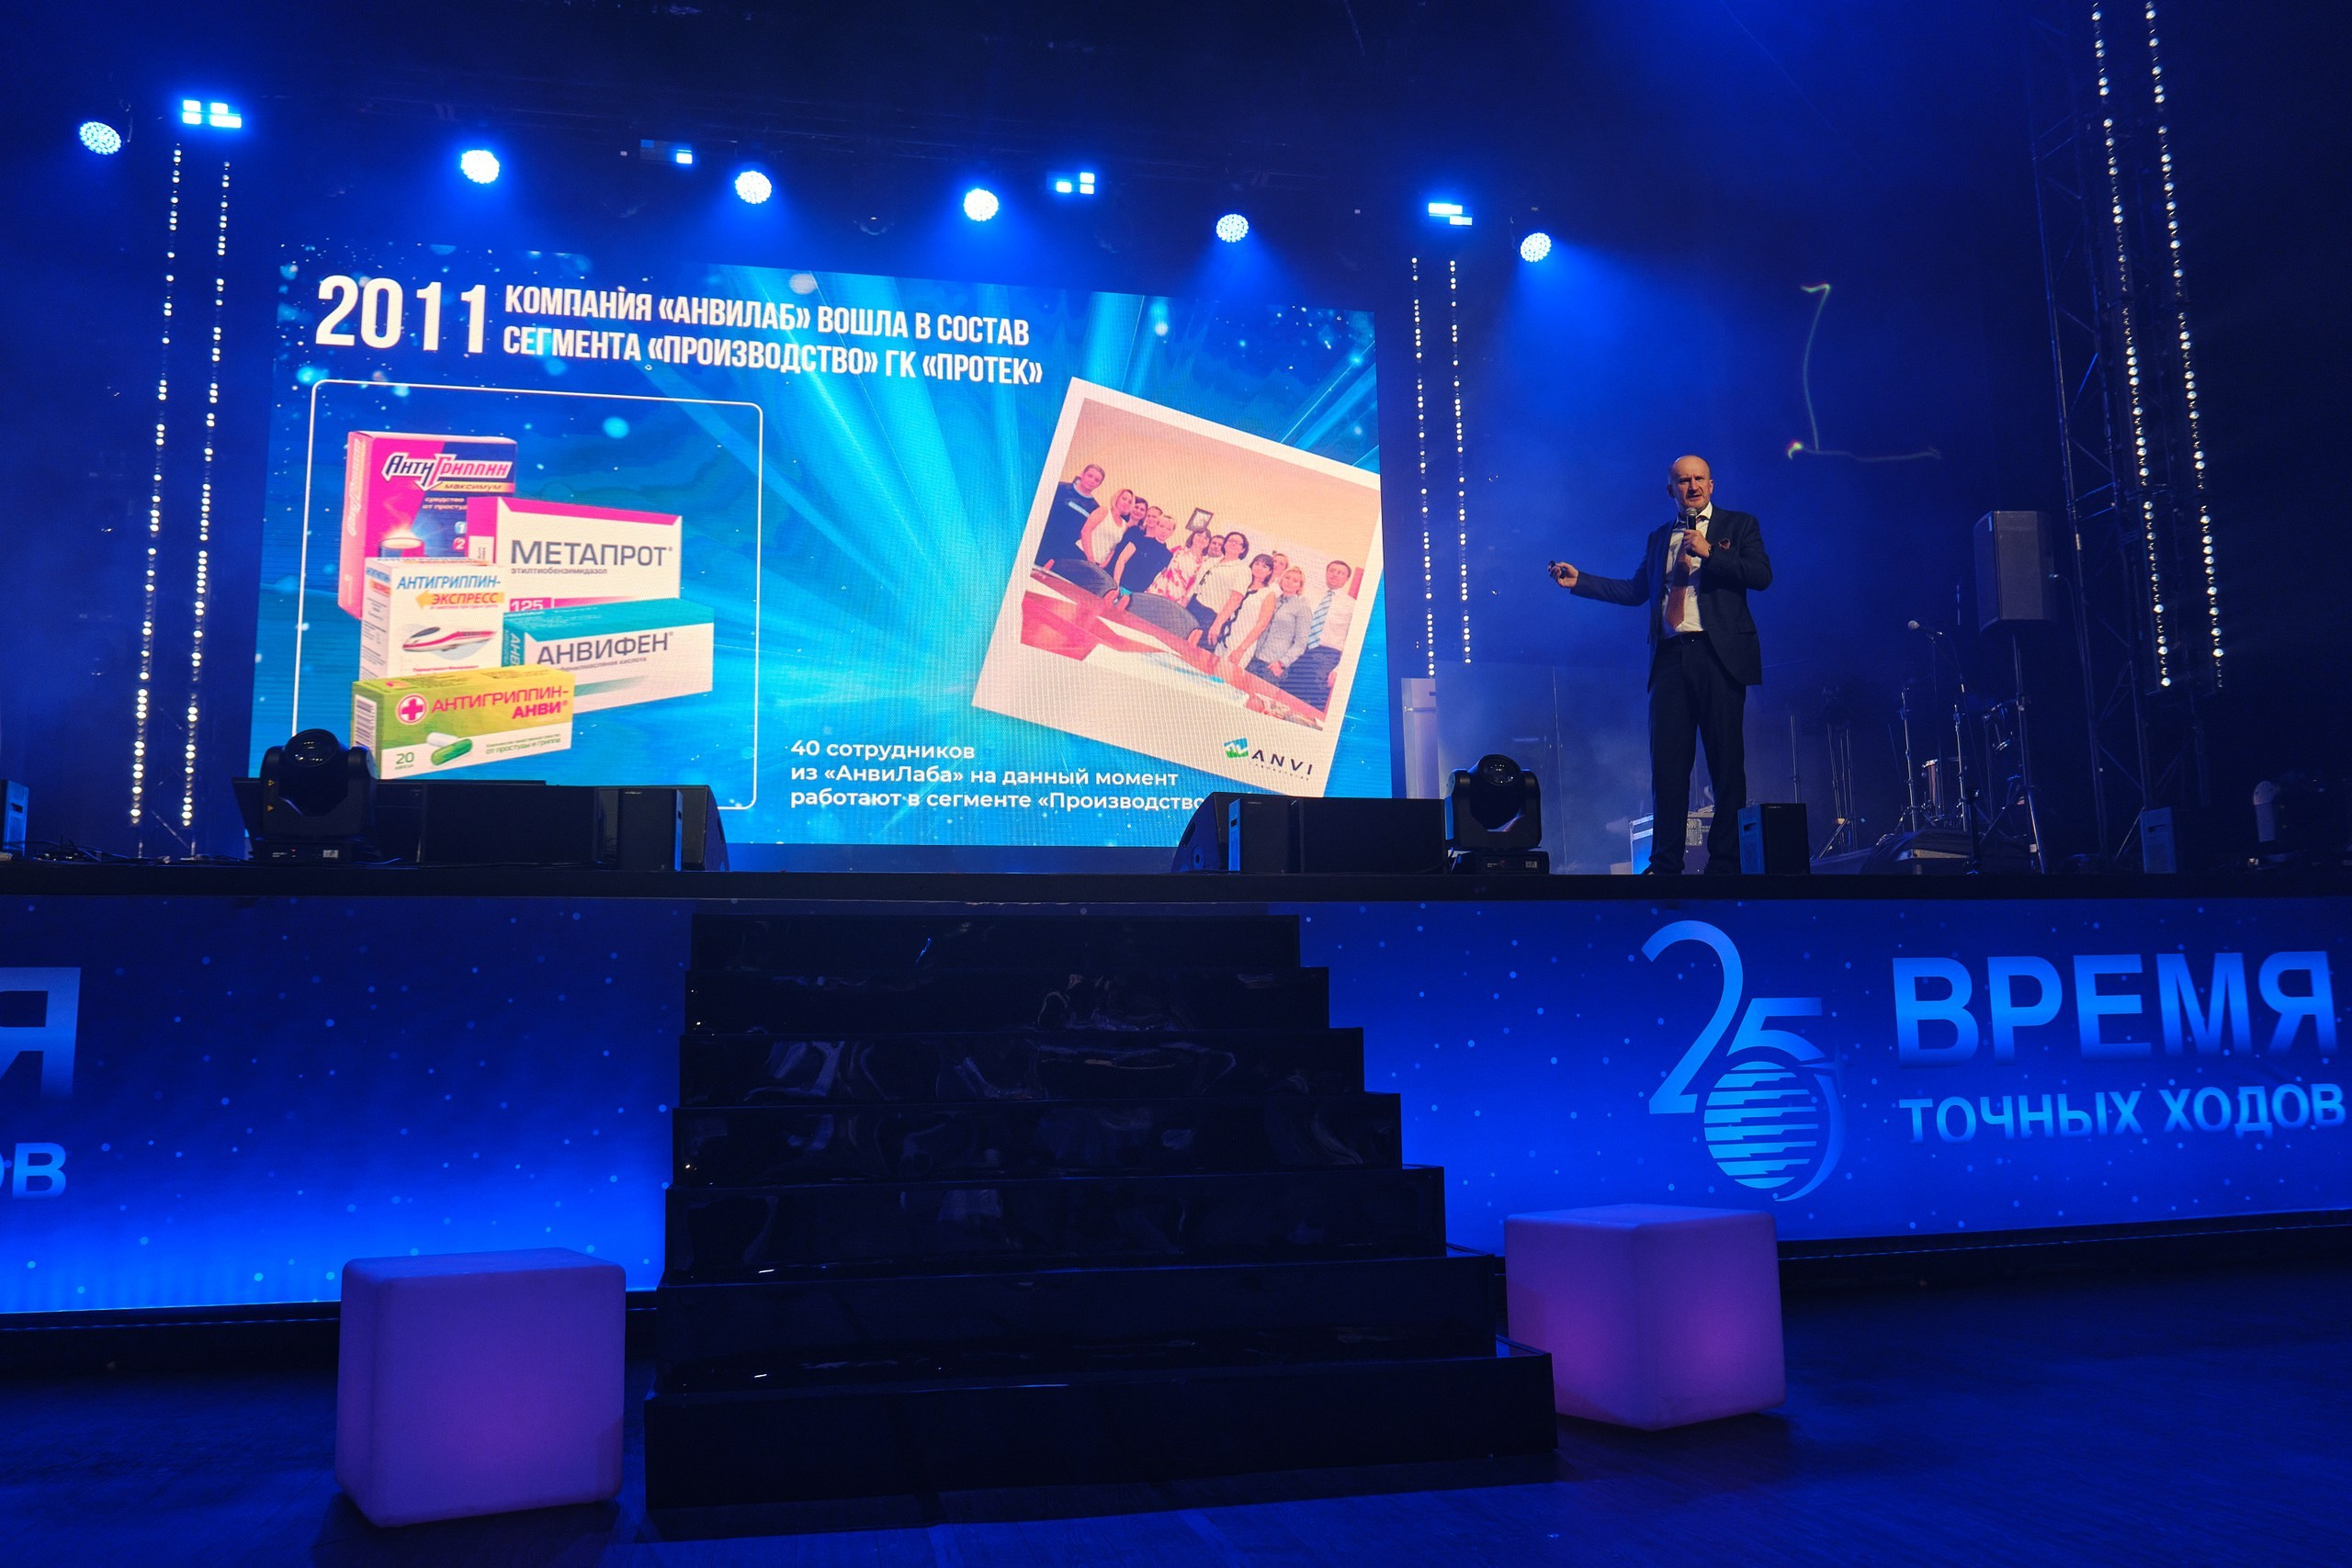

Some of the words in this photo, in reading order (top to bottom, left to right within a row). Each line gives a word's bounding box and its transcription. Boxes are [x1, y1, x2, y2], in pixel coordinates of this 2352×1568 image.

[315, 274, 486, 355] 2011
[505, 285, 652, 321] КОМПАНИЯ
[659, 295, 810, 331] «АНВИЛАБ»
[818, 305, 909, 339] ВОШЛА
[915, 312, 931, 340] В
[937, 314, 1030, 346] СОСТАВ
[503, 325, 641, 361] СЕГМЕНТА
[647, 334, 878, 375] «ПРОИЗВОДСТВО»
[885, 349, 916, 378] ГК
[922, 353, 1043, 385] «ПРОТЕК»
[431, 592, 499, 605] ЭКСПРЕСС
[396, 751, 414, 764] 20
[790, 739, 820, 757] 40
[826, 743, 975, 761] сотрудников
[1251, 749, 1313, 775] ANVI
[791, 767, 818, 781] из
[824, 765, 963, 783] «АнвиЛаба»
[970, 770, 996, 784] на
[1001, 768, 1090, 786] данный
[1095, 772, 1179, 786] момент
[790, 787, 902, 808] работают
[908, 794, 921, 807] в
[926, 795, 1031, 809] сегменте
[1891, 950, 2339, 1069] ВРЕМЯ
[1898, 1089, 2145, 1144] ТОЧНЫХ
[2157, 1083, 2347, 1139] ХОДОВ
